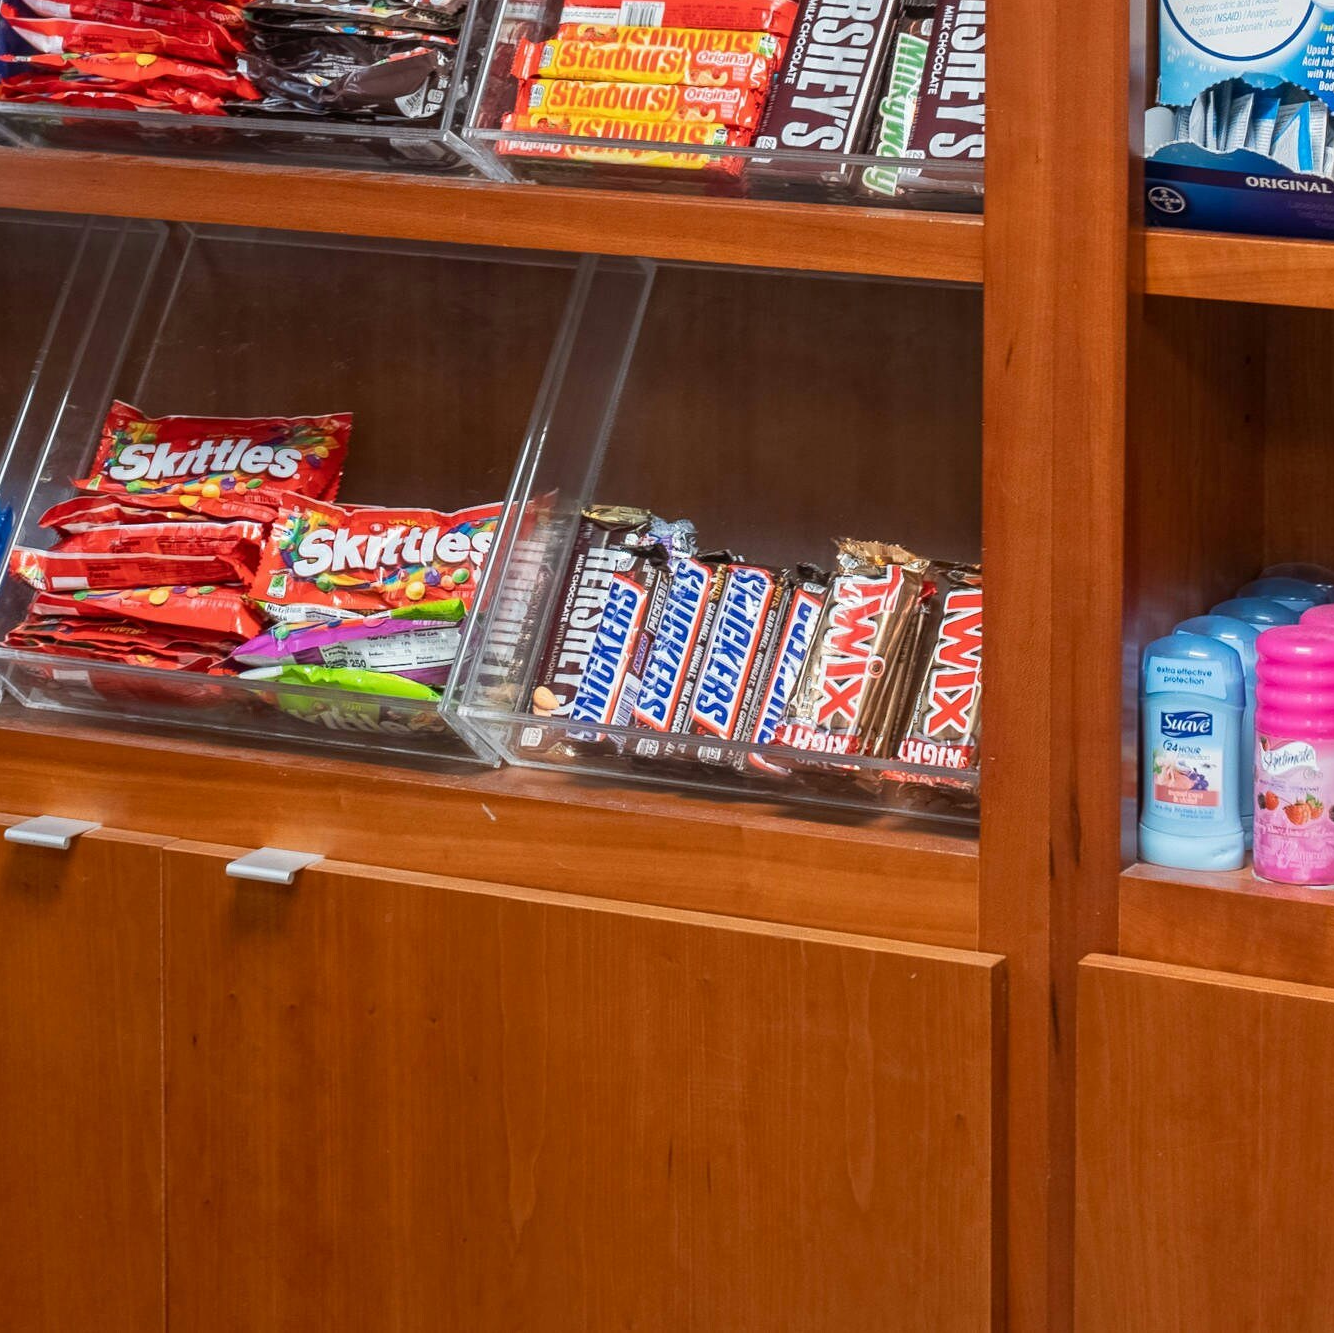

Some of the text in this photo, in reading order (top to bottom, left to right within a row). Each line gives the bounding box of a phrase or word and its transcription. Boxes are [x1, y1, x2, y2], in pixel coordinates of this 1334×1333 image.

[560, 39, 687, 74] Starburst
[696, 50, 751, 66] Original
[785, 21, 812, 85] CHOCOLATE
[928, 31, 950, 96] CHOCOLATE
[1303, 57, 1320, 67] Acid
[1307, 46, 1329, 57] Upset
[1307, 69, 1324, 79] with
[549, 82, 678, 113] Starburst
[687, 88, 740, 102] Original
[1246, 176, 1332, 194] ORIGINAL
[109, 438, 303, 481] Skittles
[293, 527, 494, 578] Skittles
[636, 562, 705, 722] SNICKERS
[695, 569, 767, 726] SNICKERS
[1163, 714, 1211, 732] Suave
